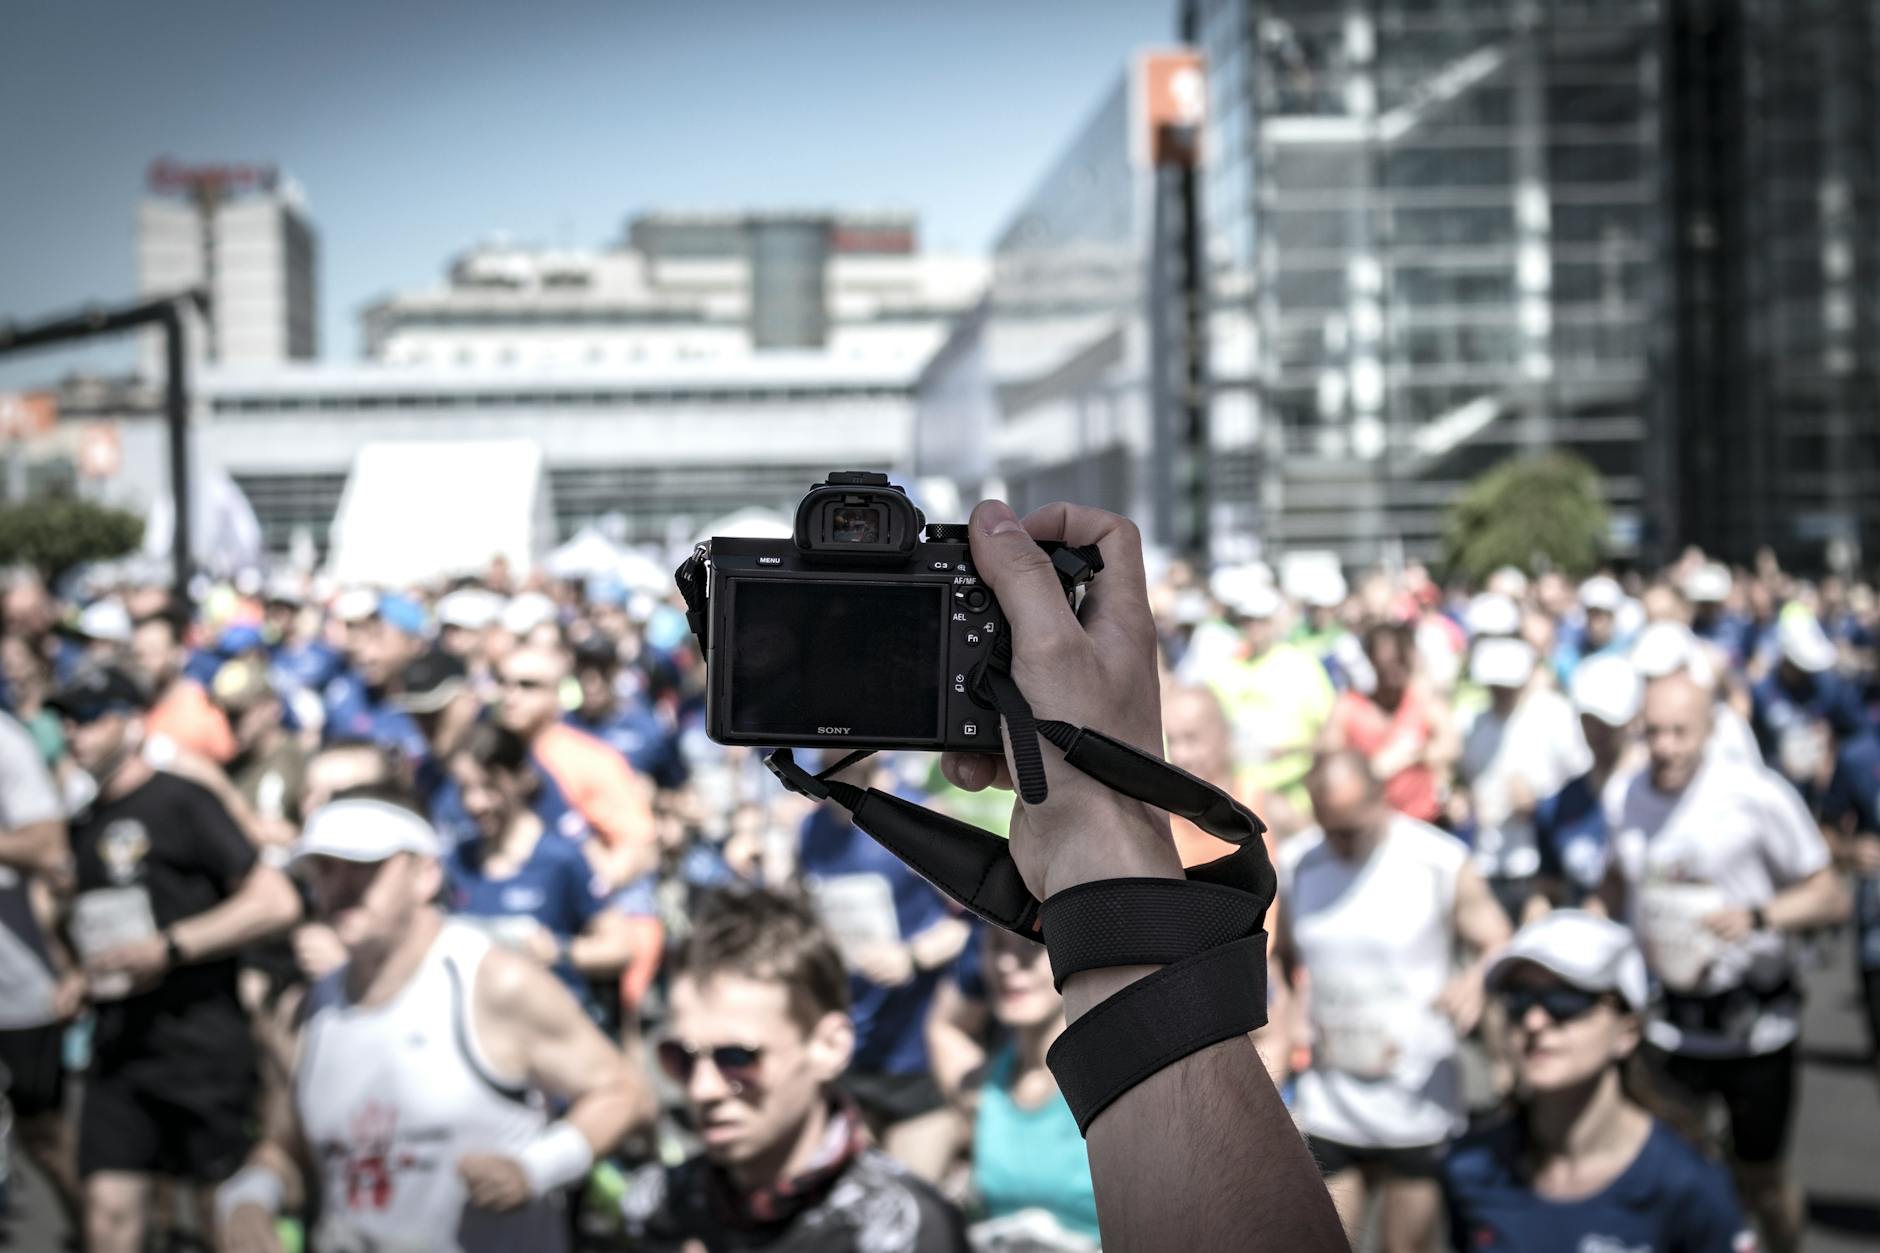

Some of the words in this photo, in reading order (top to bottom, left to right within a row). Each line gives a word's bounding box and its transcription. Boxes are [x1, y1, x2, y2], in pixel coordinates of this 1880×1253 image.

[953, 576, 977, 585] AF/MF
[952, 613, 967, 621] AEL
[967, 634, 979, 643] Fn
[817, 726, 851, 735] SONY
